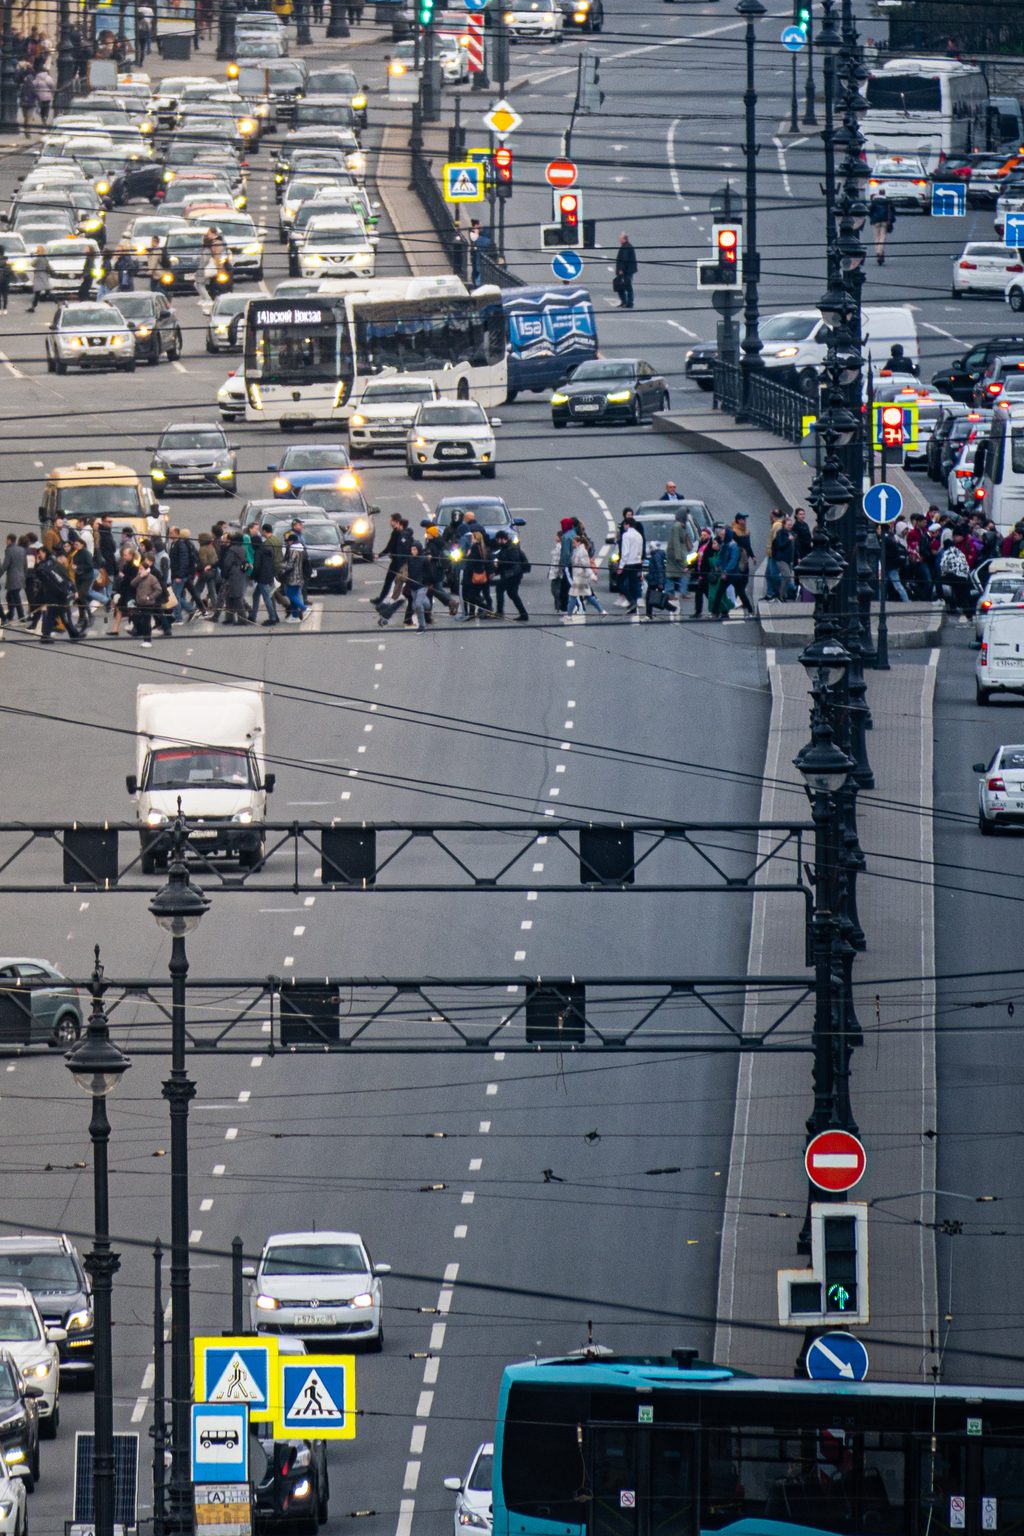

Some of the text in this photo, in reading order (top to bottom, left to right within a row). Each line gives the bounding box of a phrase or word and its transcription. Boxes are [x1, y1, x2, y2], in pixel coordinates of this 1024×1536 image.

[568, 213, 576, 225] 4
[726, 250, 735, 263] 4
[884, 428, 902, 446] 34
